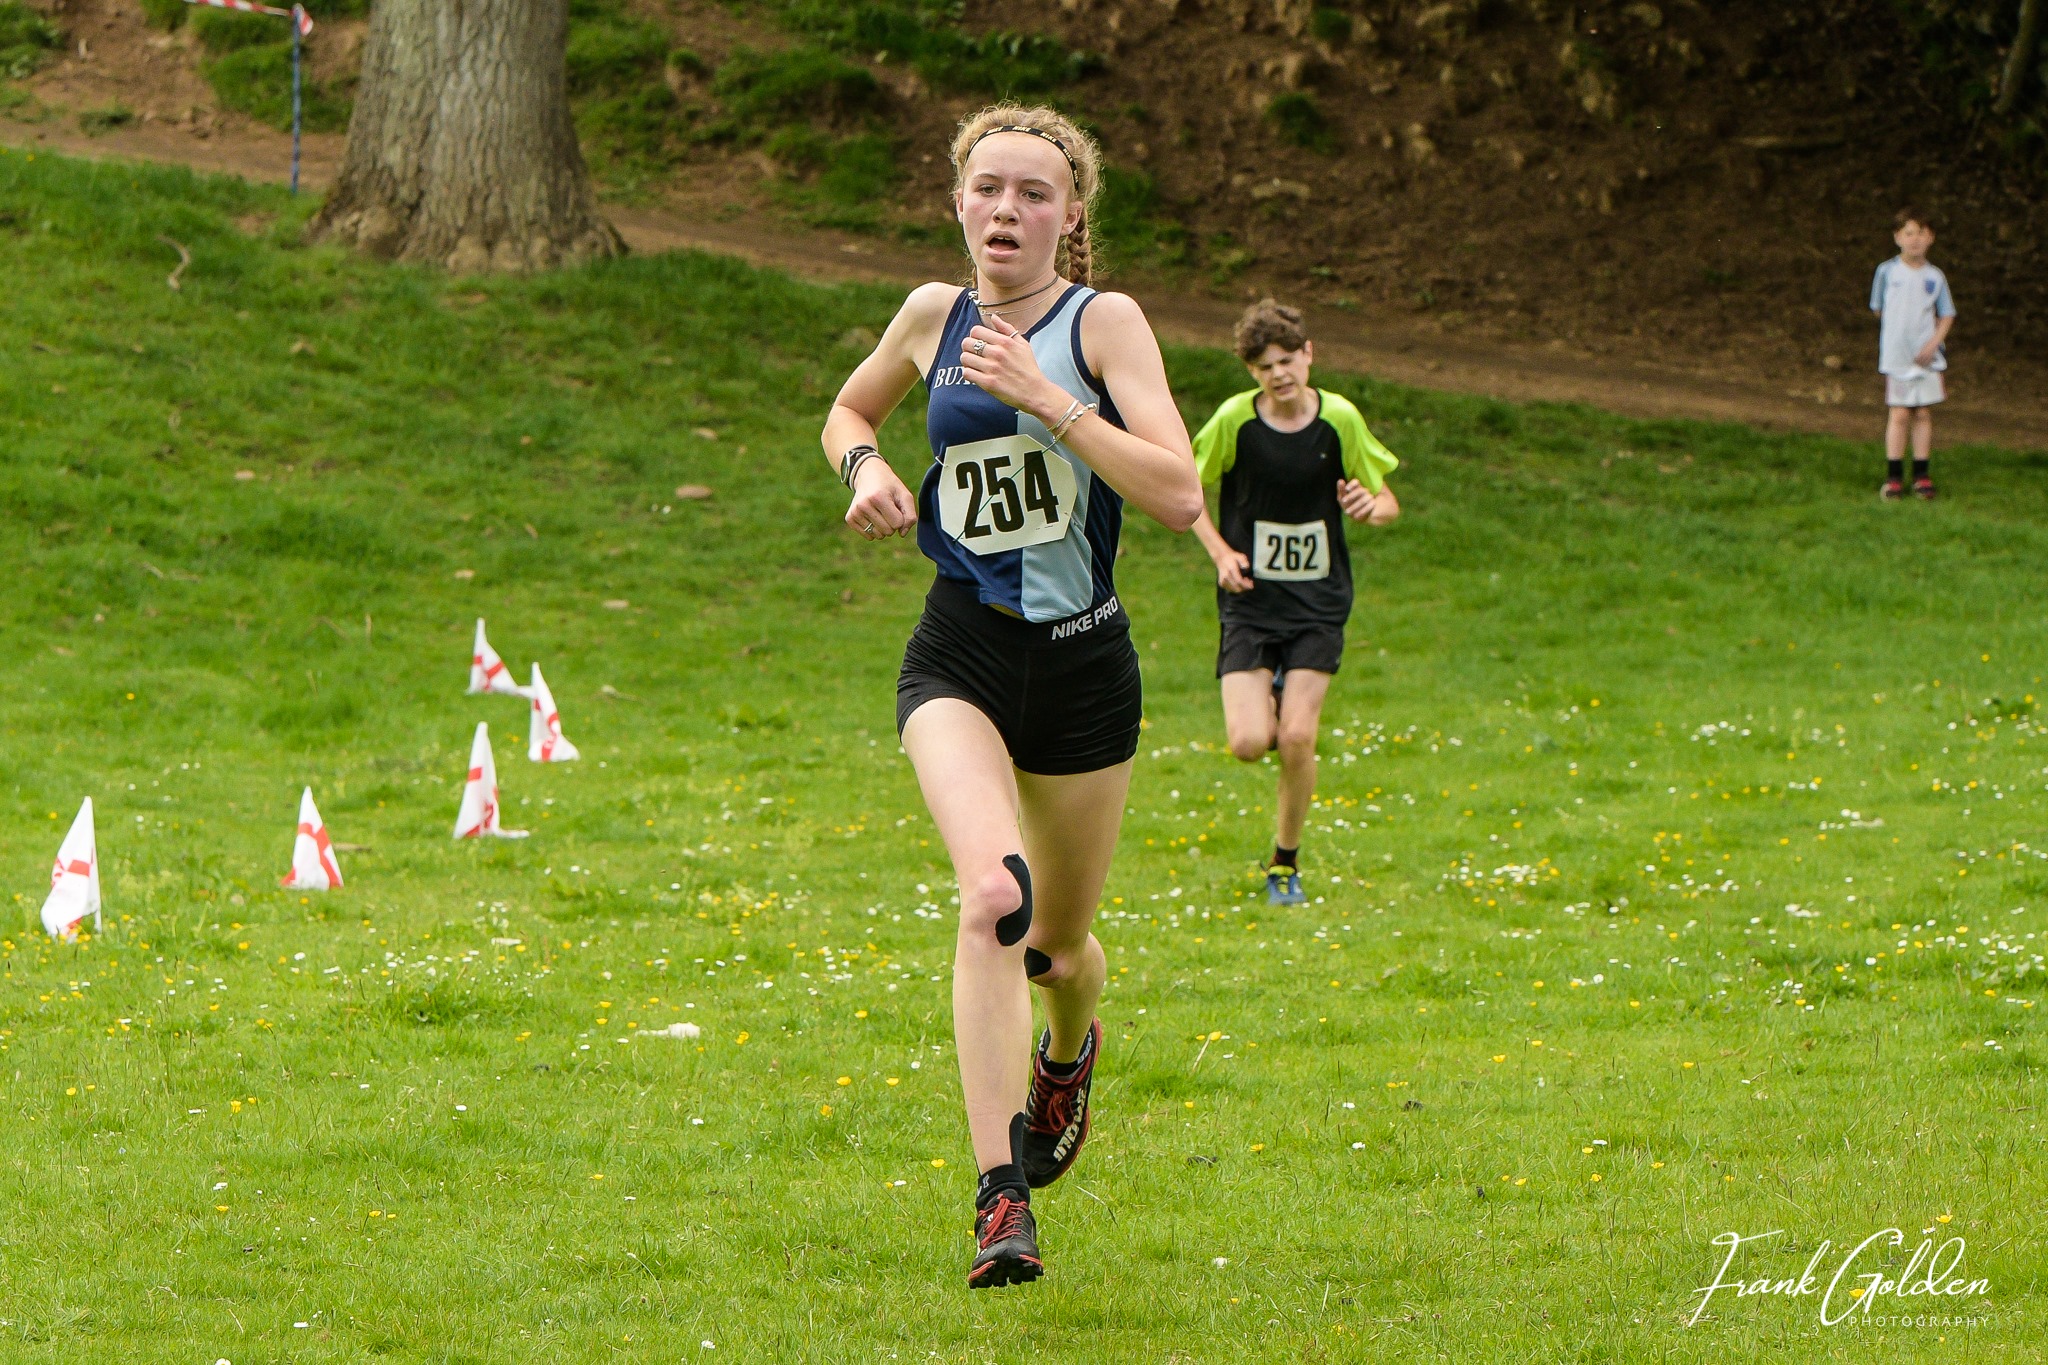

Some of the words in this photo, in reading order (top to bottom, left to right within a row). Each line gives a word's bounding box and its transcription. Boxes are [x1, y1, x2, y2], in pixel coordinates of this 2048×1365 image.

[1040, 131, 1057, 143] NIKE
[934, 366, 976, 389] BUX
[955, 450, 1060, 539] 254
[1267, 533, 1319, 571] 262
[1051, 613, 1093, 640] NIKE
[1094, 595, 1119, 626] PRO
